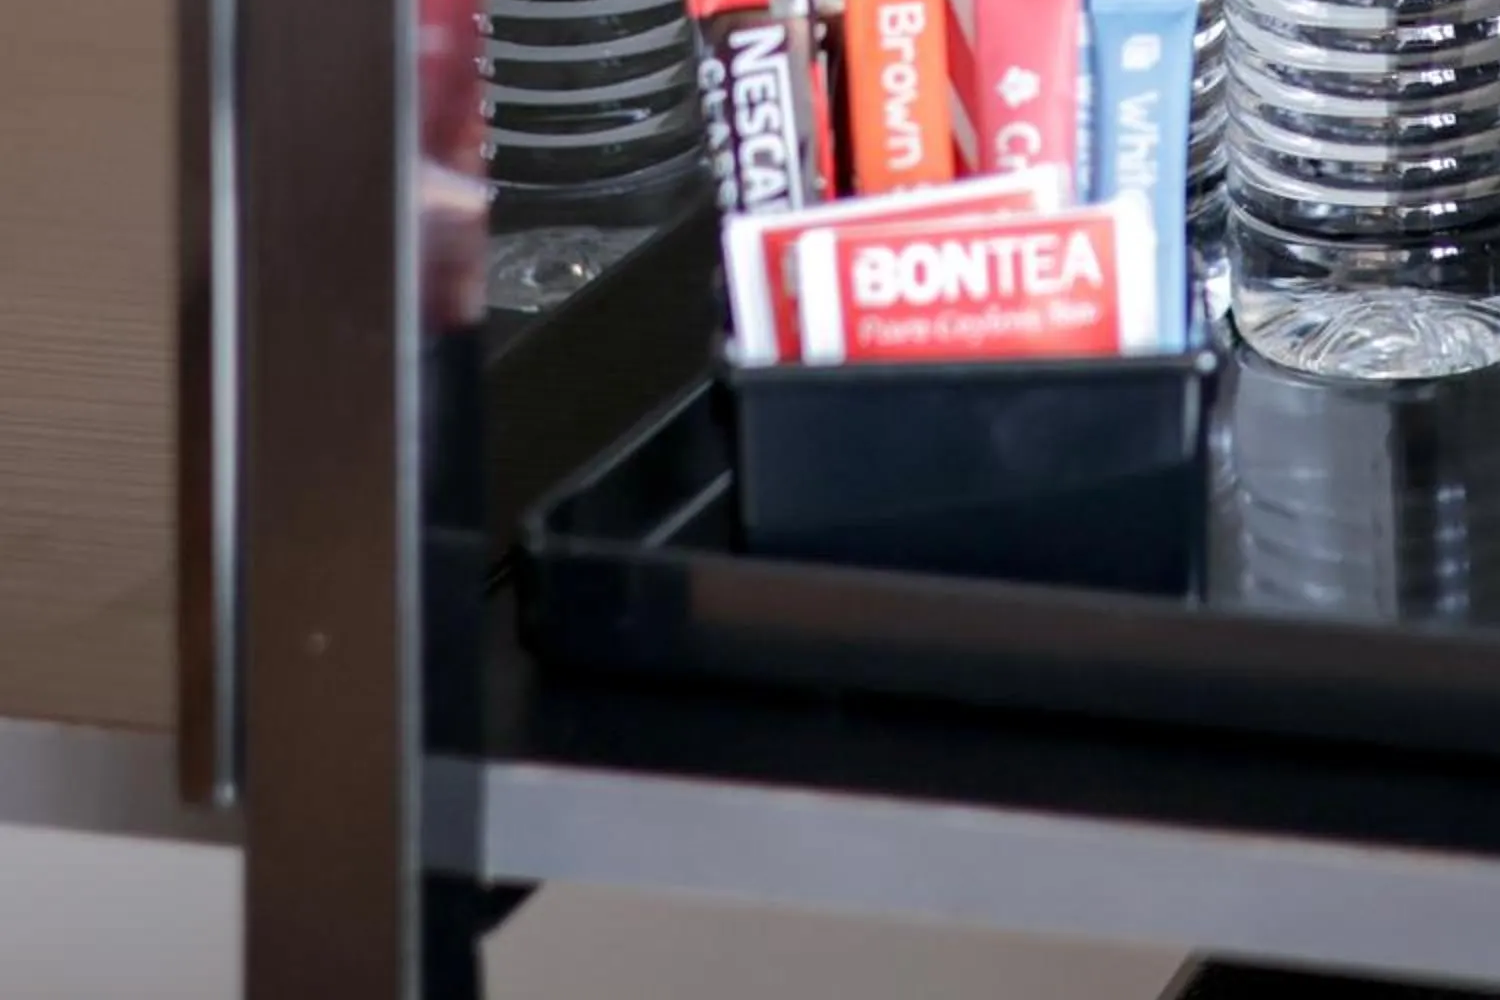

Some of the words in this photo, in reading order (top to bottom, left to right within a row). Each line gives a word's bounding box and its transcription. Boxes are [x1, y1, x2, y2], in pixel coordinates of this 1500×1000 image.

[697, 56, 739, 210] CLASS
[728, 23, 804, 213] NESCA
[878, 1, 926, 172] Brown
[1117, 90, 1159, 188] Whit
[853, 229, 1104, 311] BONTEA
